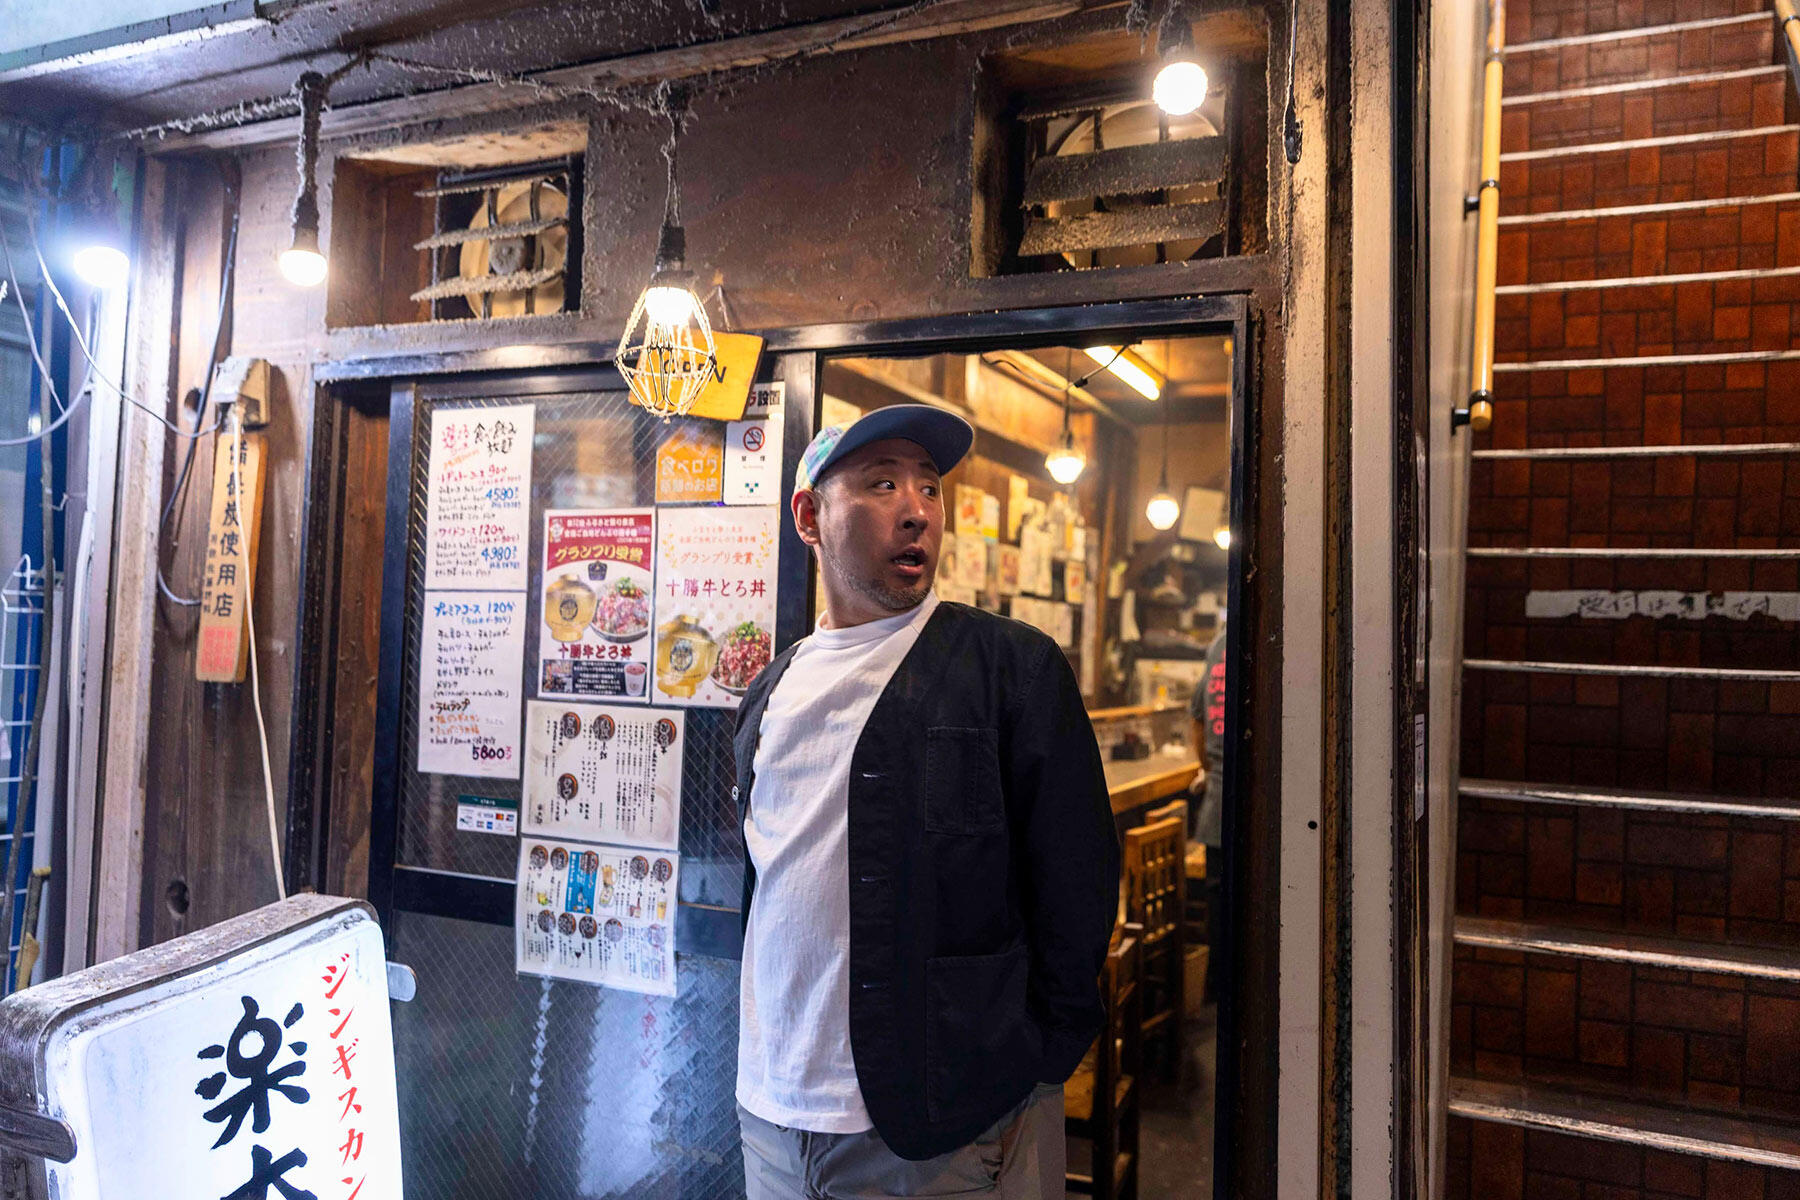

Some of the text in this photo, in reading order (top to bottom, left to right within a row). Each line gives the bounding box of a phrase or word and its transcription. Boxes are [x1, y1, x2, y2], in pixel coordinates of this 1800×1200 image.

[661, 456, 718, 476] 食べログ
[555, 544, 643, 563] グランプリ受賞
[681, 551, 754, 565] グランプリ受賞
[666, 578, 767, 598] 十勝牛とろ丼
[558, 642, 632, 660] 十勝牛とろ丼
[472, 744, 505, 761] 5800
[321, 953, 367, 1200] ジンギスカン
